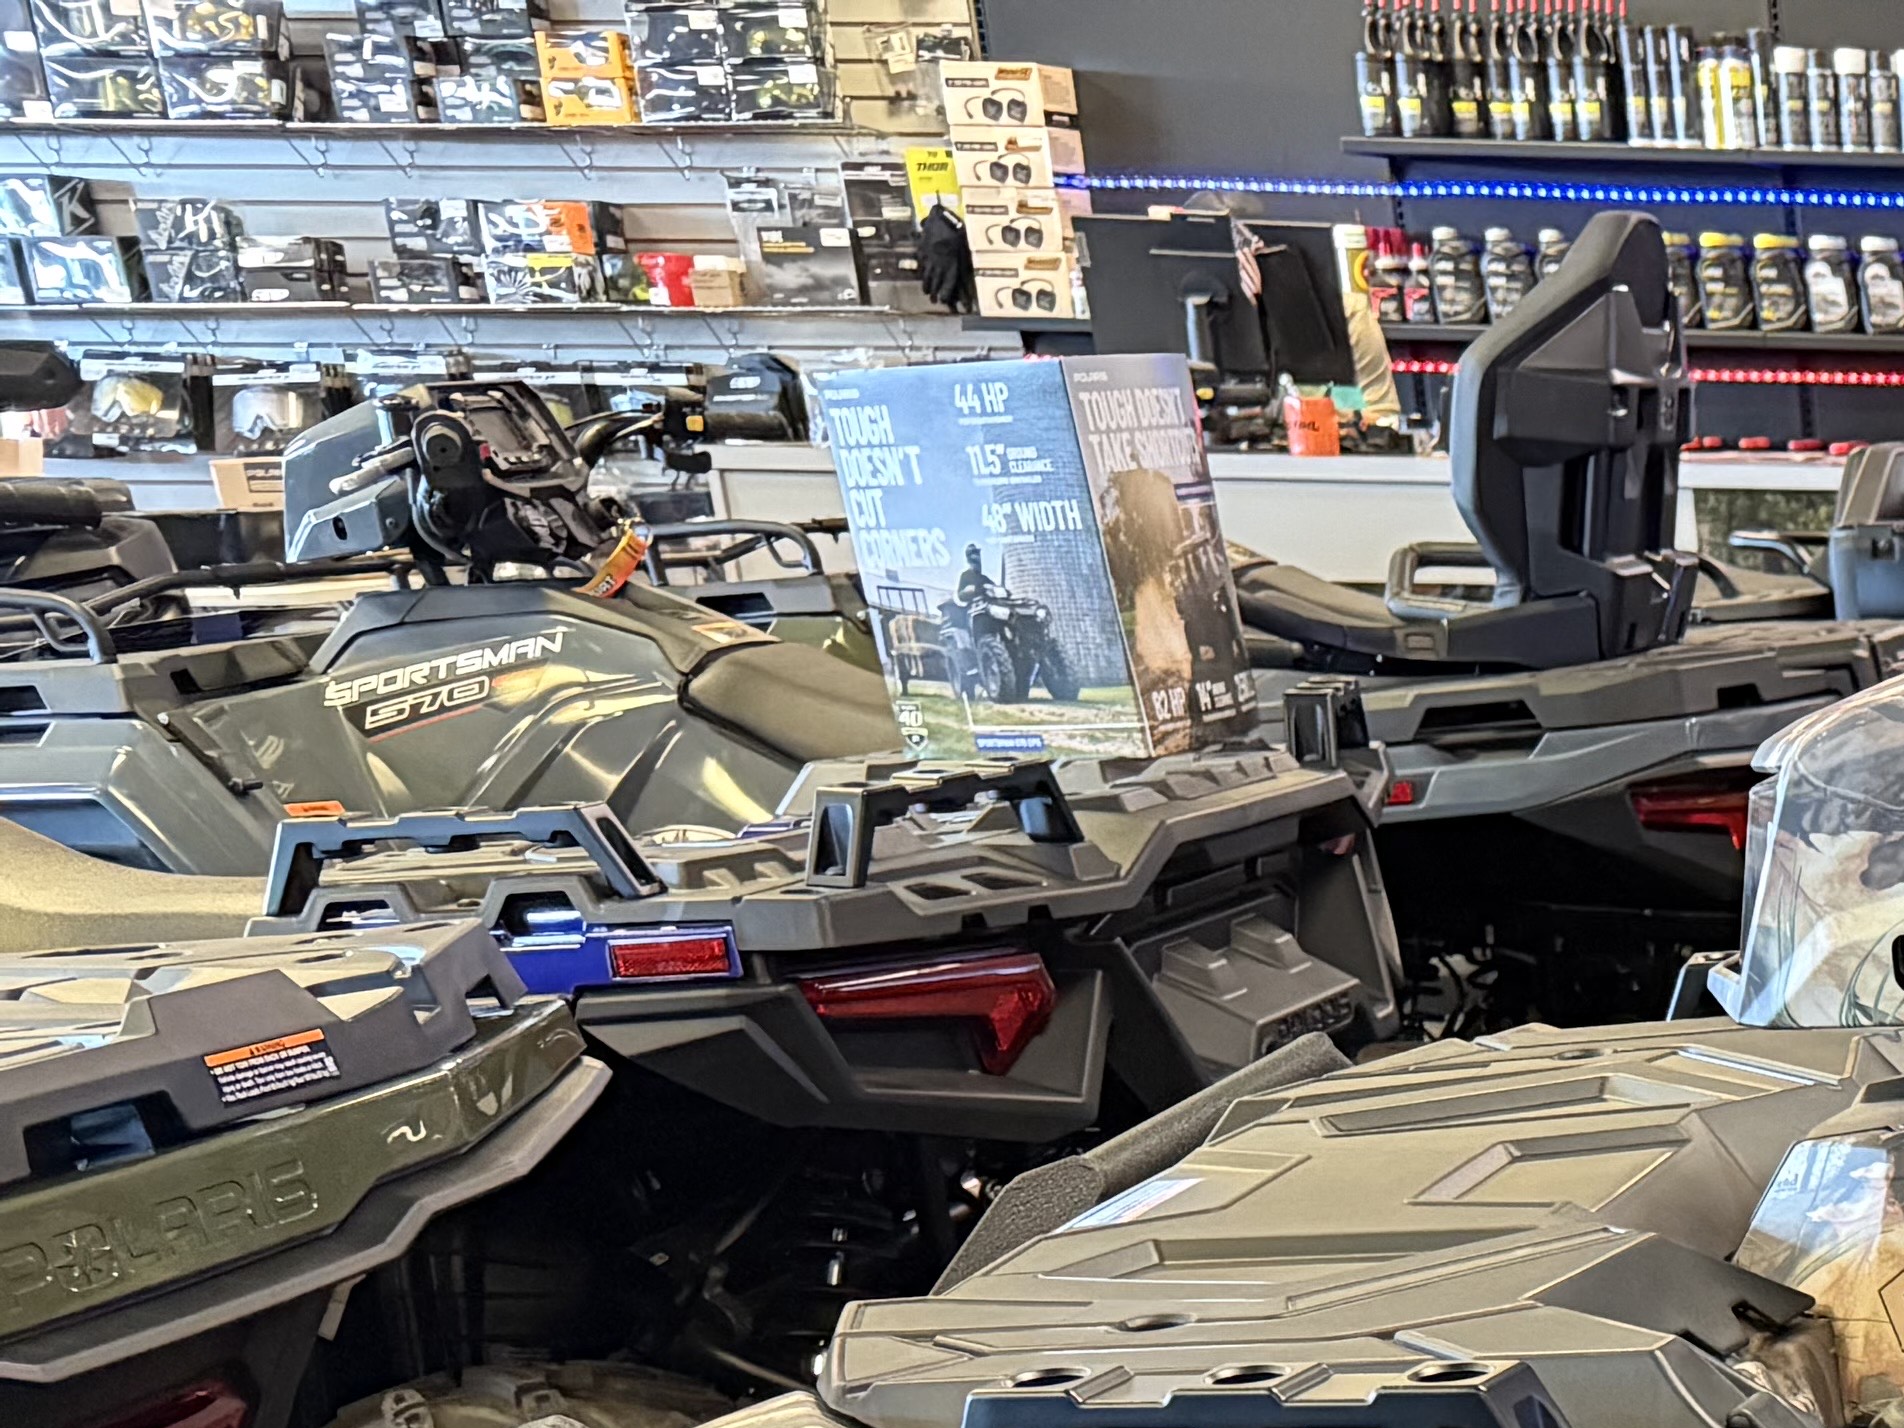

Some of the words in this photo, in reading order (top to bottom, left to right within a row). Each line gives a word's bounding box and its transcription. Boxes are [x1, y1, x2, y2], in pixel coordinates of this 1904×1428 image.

[954, 384, 982, 414] 44
[983, 382, 1009, 413] HP
[1079, 389, 1136, 431] TOUGH
[829, 405, 895, 447] TOUGH
[840, 445, 923, 487] DOESN'T
[849, 488, 886, 528] CUT
[1015, 499, 1083, 534] WIDTH
[859, 527, 951, 568] CORNERS
[324, 627, 566, 707] SPORTSMAN
[364, 675, 490, 729] 570
